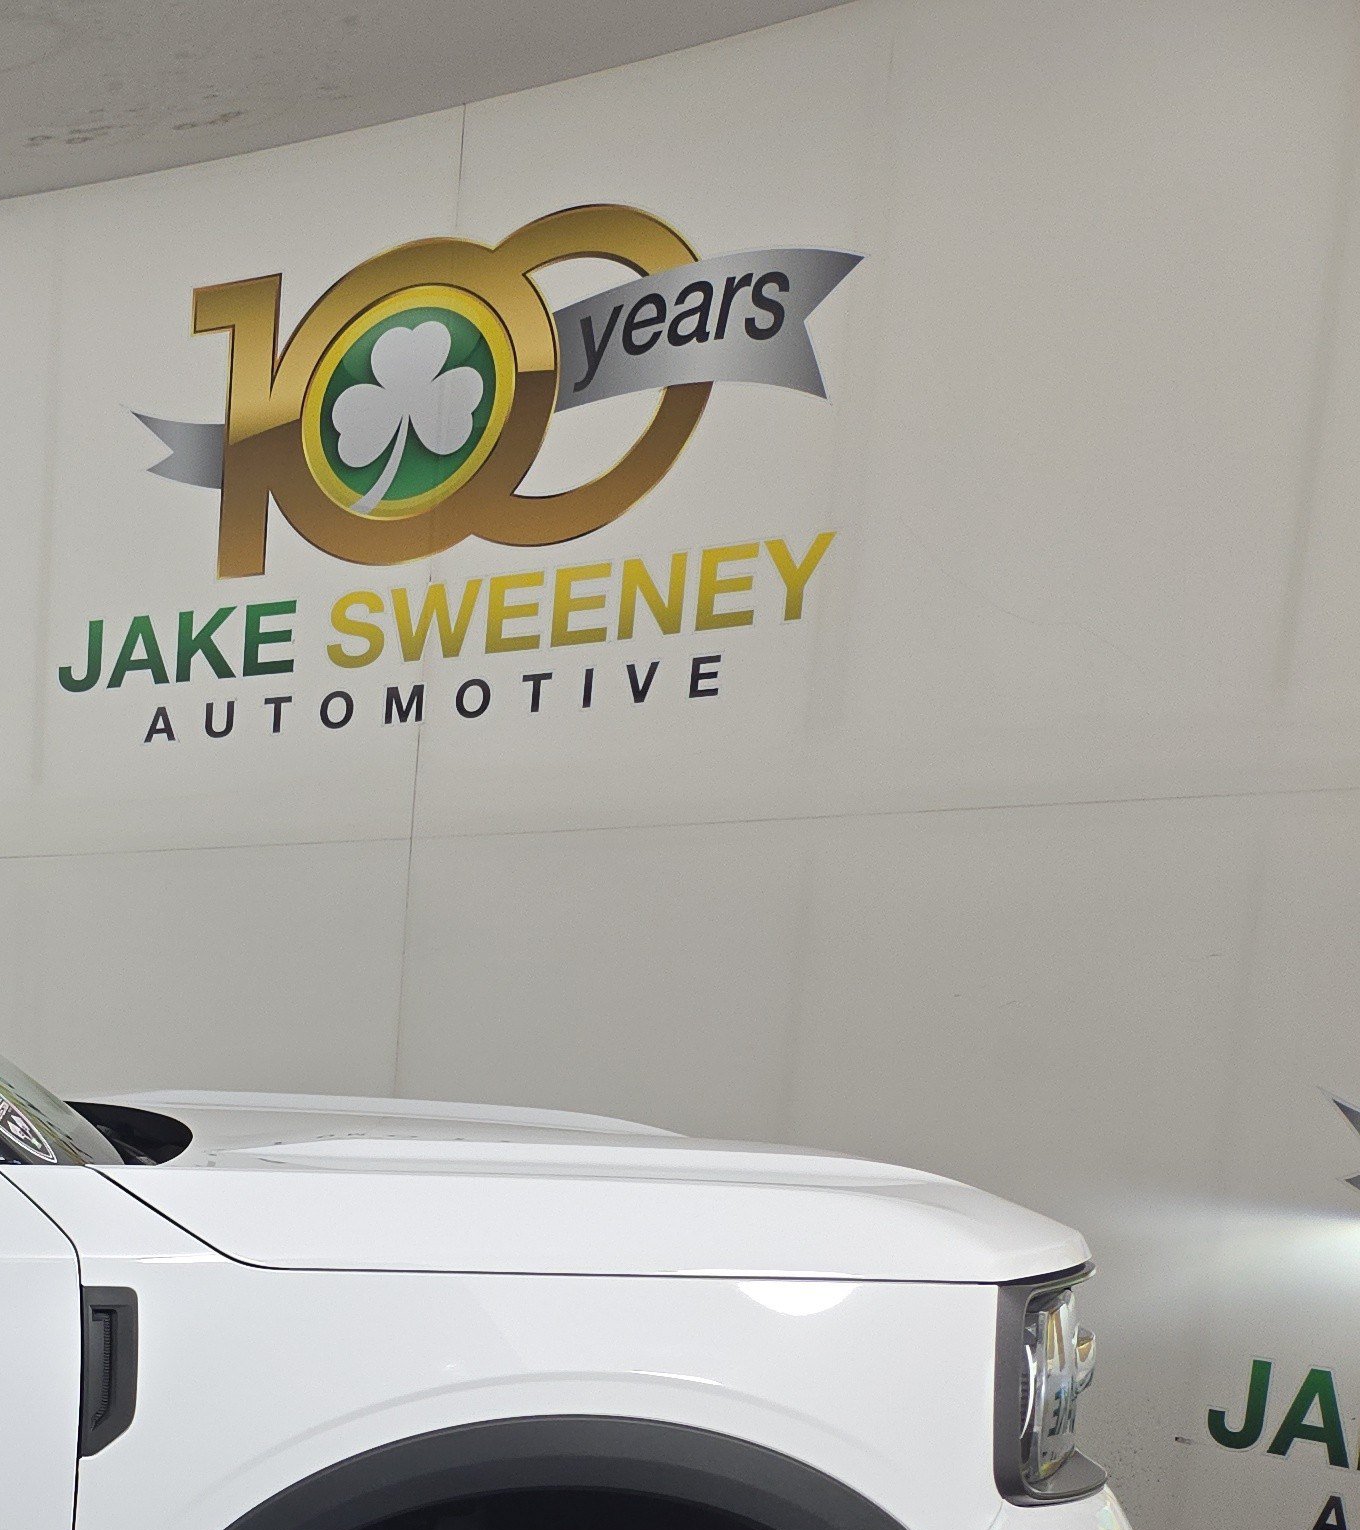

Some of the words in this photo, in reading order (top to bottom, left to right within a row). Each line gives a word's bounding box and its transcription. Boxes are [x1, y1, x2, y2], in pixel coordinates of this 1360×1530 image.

[572, 269, 790, 393] years
[58, 599, 298, 694] JAKE
[327, 531, 838, 670] SWEENEY
[143, 654, 724, 743] AUTOMOTIVE
[1208, 1359, 1360, 1471] JA
